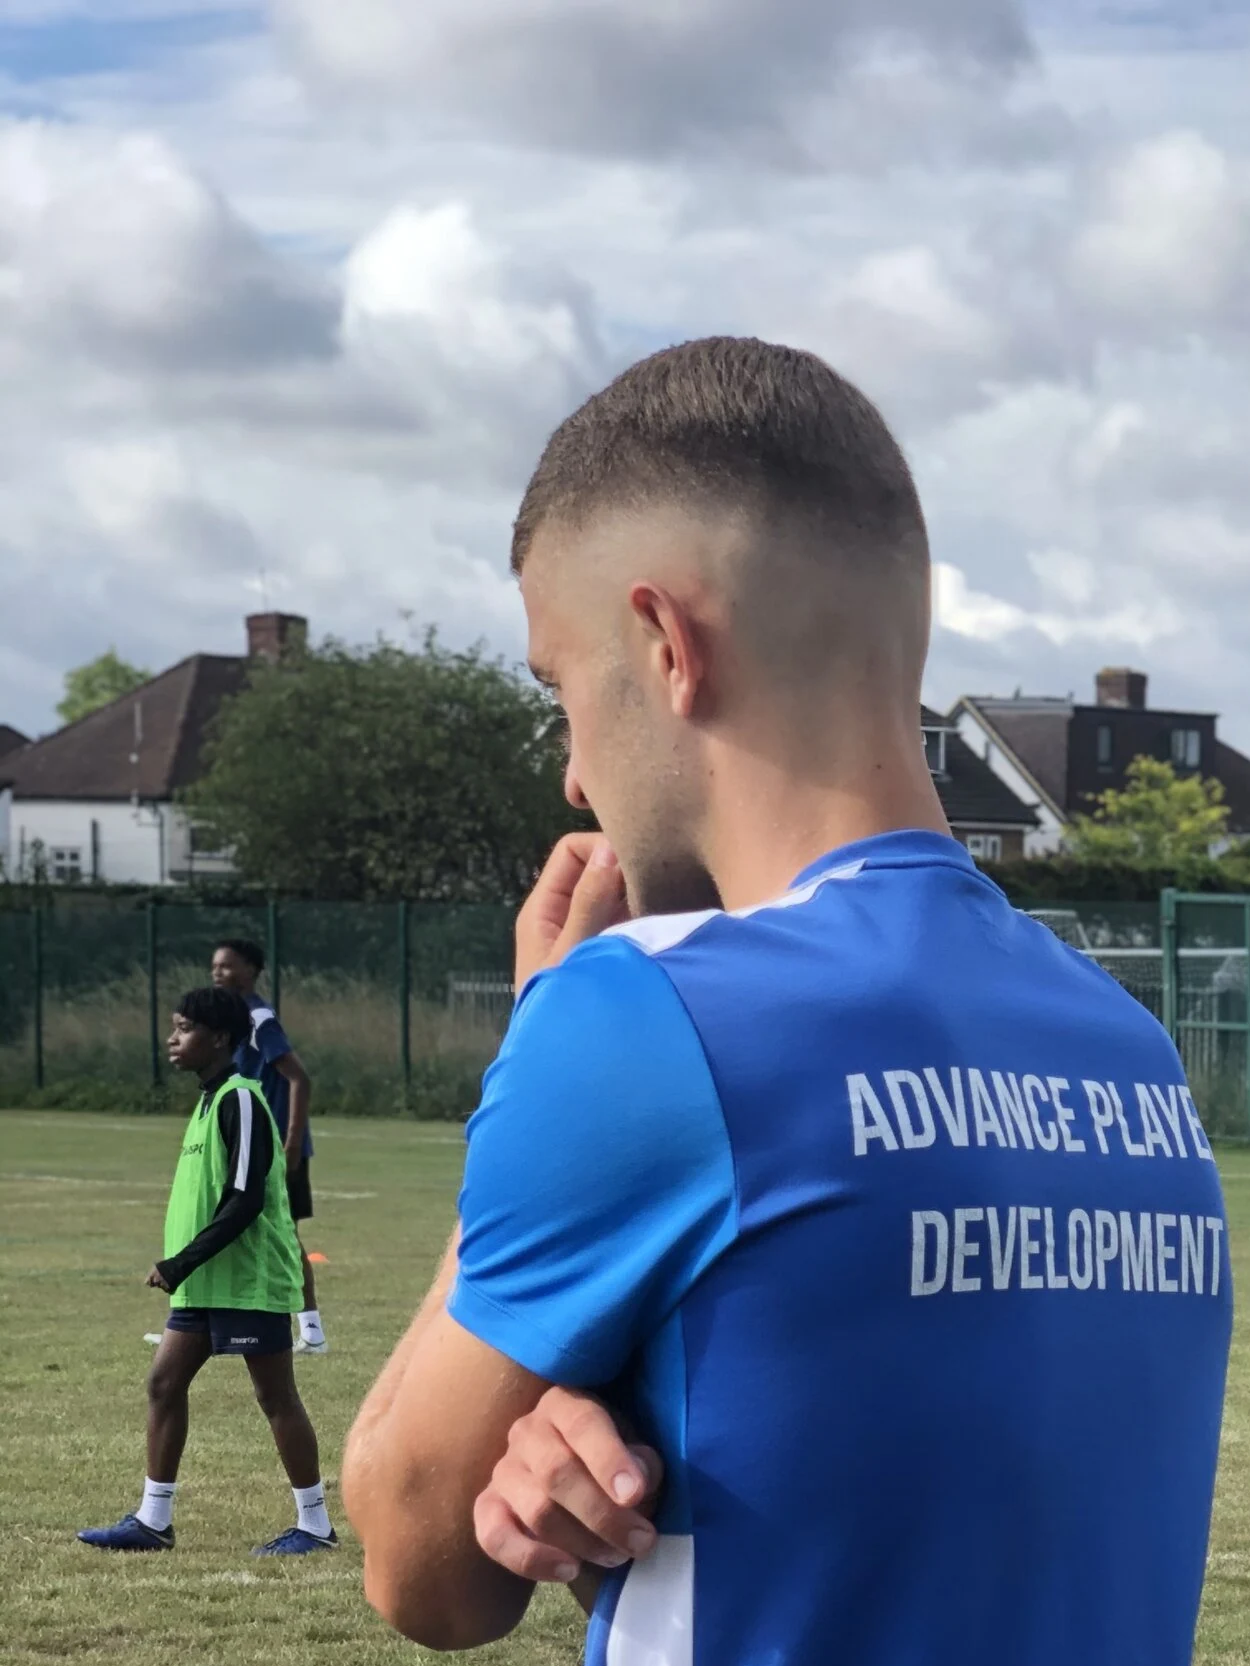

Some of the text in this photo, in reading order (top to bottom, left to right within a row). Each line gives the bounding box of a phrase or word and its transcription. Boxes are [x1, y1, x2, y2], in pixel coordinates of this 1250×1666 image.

[846, 1066, 1216, 1163] ADVANCE PLAYE
[911, 1206, 1223, 1297] DEVELOPMENT
